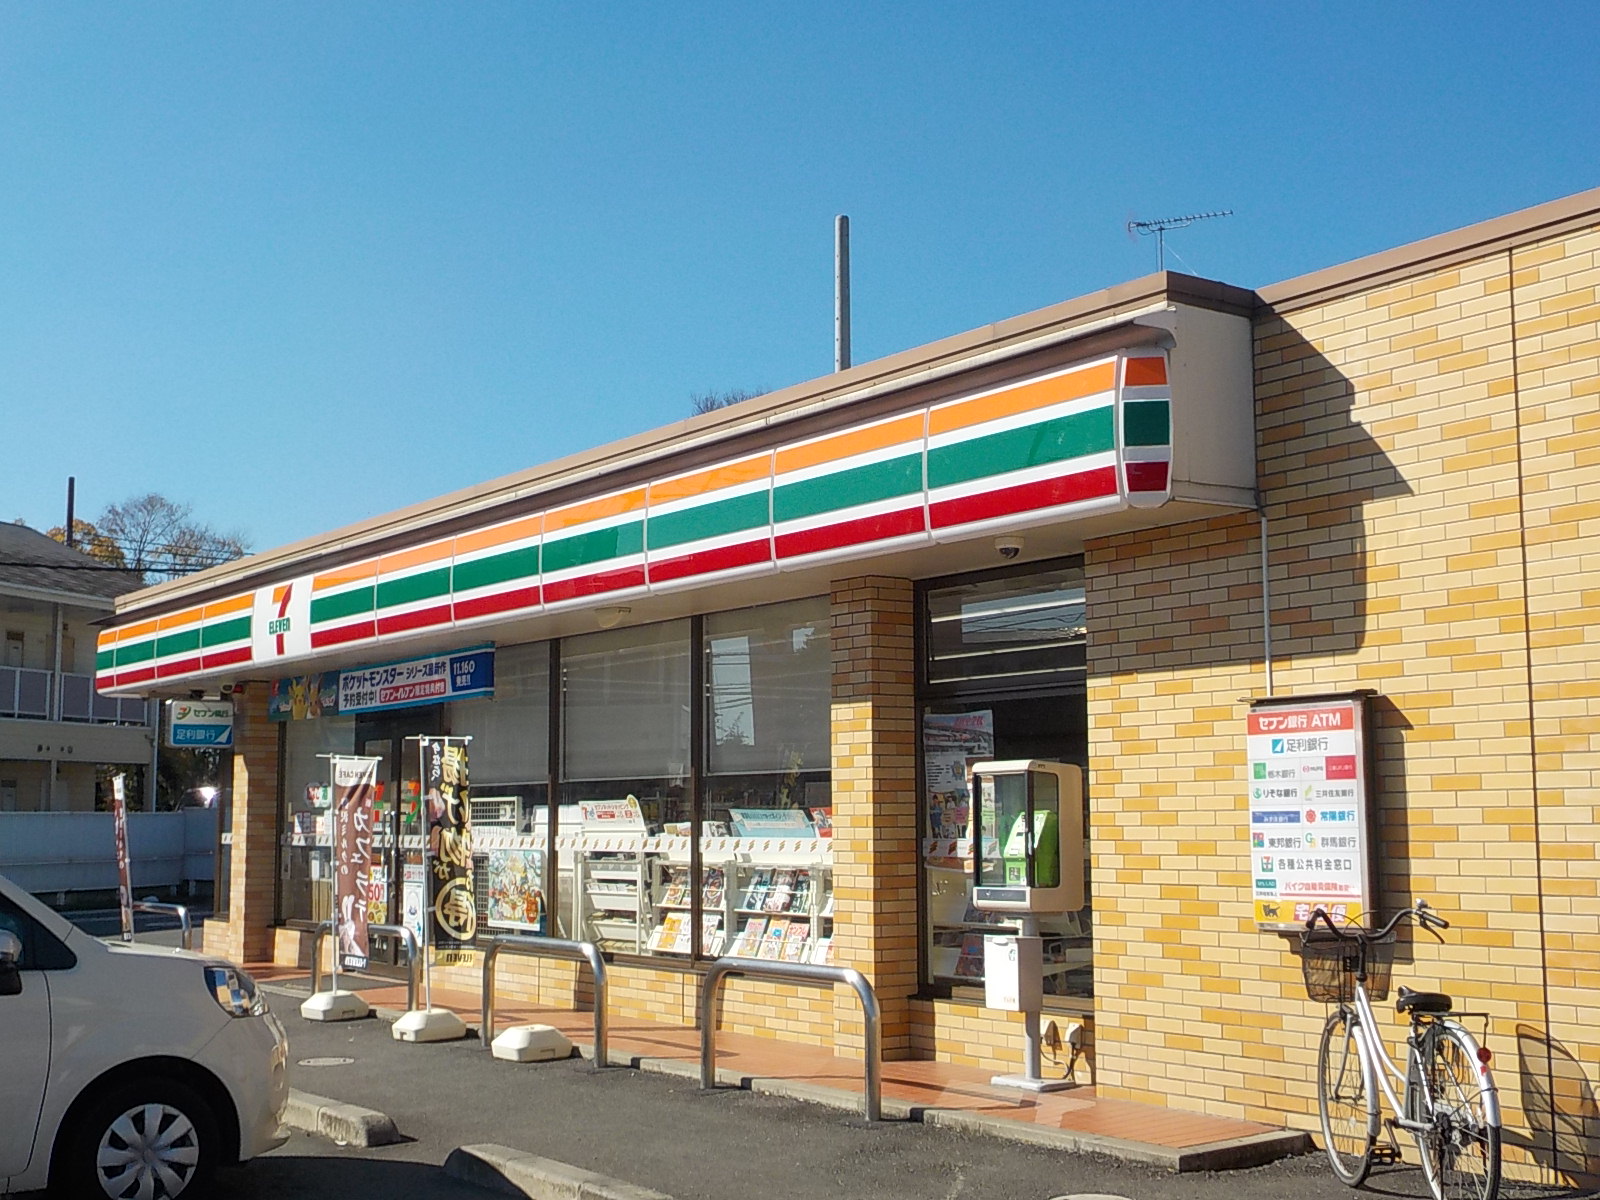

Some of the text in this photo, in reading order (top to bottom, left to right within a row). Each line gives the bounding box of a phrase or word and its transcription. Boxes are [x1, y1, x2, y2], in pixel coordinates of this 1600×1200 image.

[342, 661, 447, 691] ポケットモンスター シリーズ最新作
[1258, 712, 1341, 731] セブン銀行 ATM
[176, 728, 216, 740] 足利銀行
[1286, 737, 1328, 752] 足利銀行
[1263, 788, 1298, 798] りそな銀行
[1315, 788, 1354, 799] 三井住友銀行
[1268, 837, 1302, 849] 東邦銀行
[1321, 836, 1356, 848] 群馬銀行
[1278, 858, 1352, 871] 各種公共料金窓口
